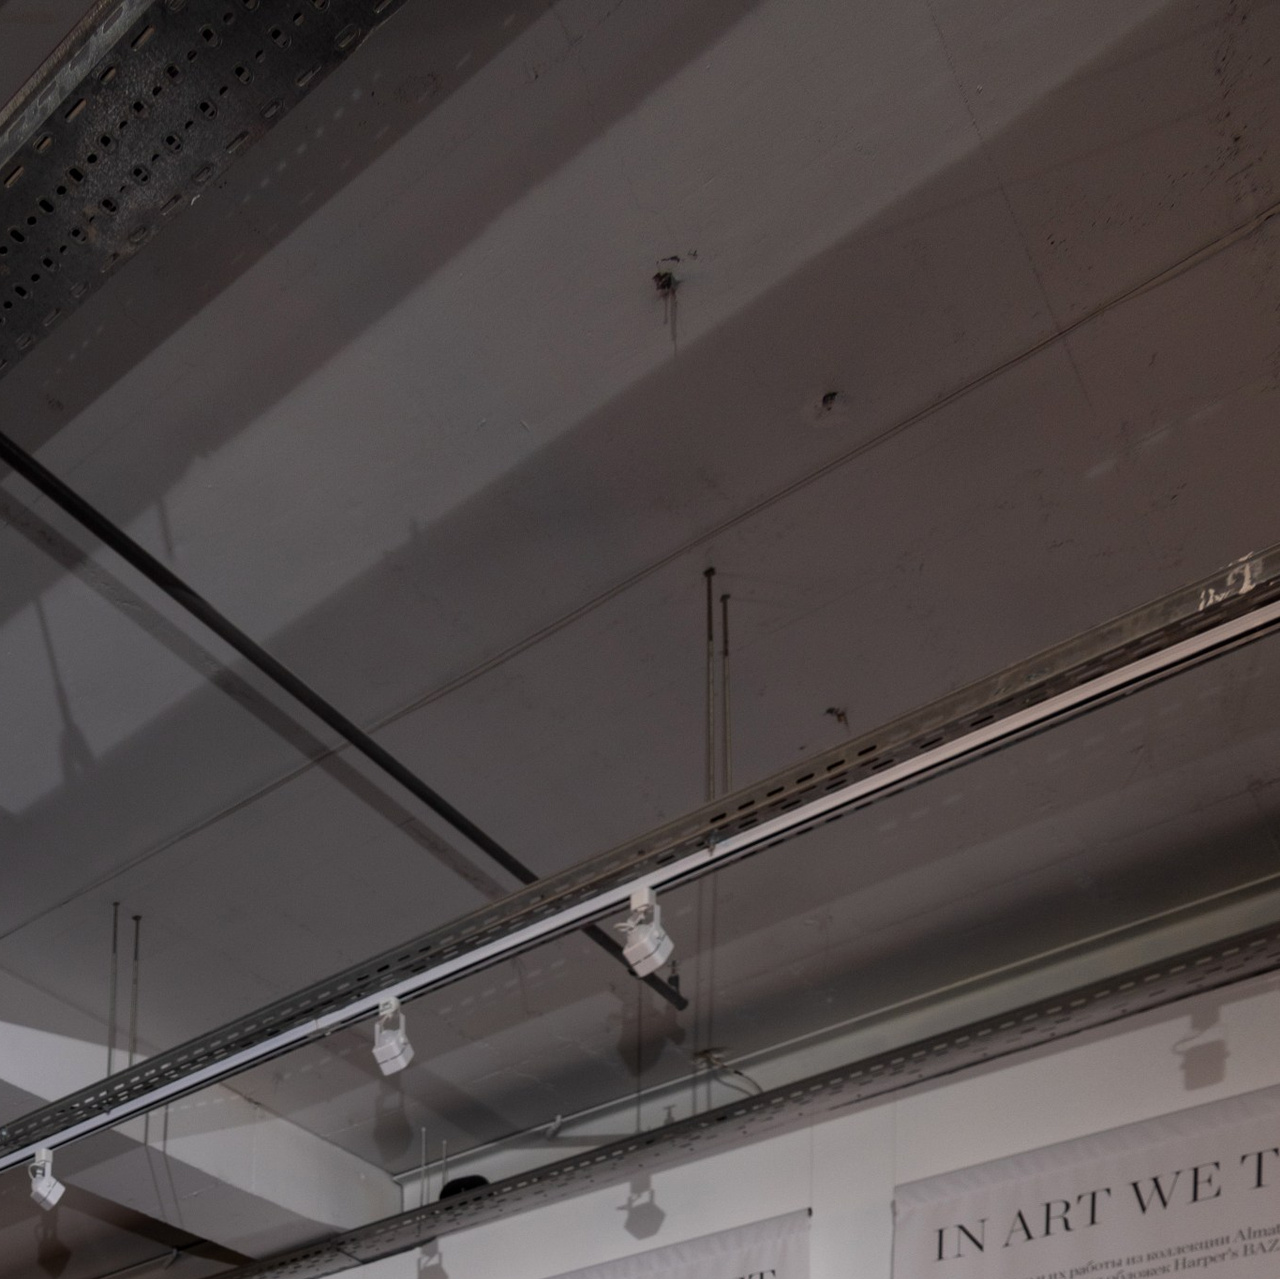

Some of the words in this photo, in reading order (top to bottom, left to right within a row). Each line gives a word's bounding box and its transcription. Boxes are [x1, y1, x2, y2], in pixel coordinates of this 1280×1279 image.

[932, 1218, 990, 1262] IN
[1002, 1187, 1112, 1249] ART
[1128, 1160, 1222, 1216] WE
[1068, 1260, 1122, 1279] работы
[1173, 1248, 1239, 1272] Harper's
